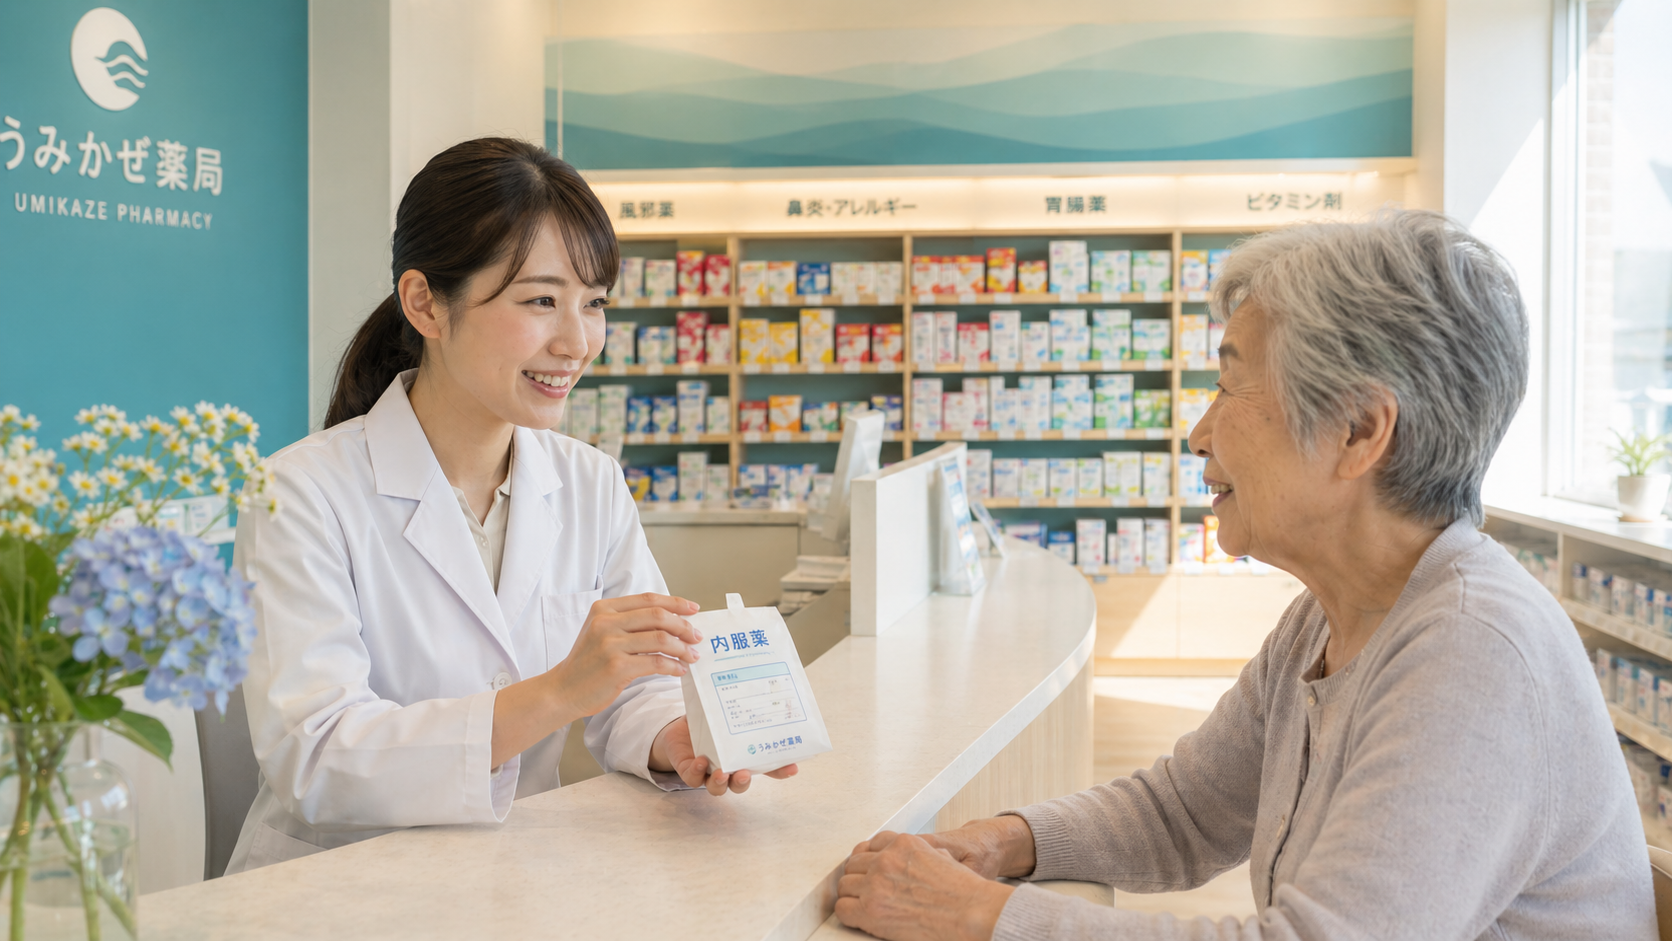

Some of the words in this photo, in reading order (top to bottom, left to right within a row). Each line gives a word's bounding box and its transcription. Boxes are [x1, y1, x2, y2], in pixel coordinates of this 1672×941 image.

[0, 116, 223, 196] うみかぜ薬局
[15, 193, 108, 221] UMIKAZE
[117, 202, 213, 231] PHARMACY
[620, 202, 674, 219] 風邪薬
[1045, 196, 1107, 213] 胃腸薬
[1247, 192, 1343, 211] ビタミン剤
[710, 629, 770, 654] 内服薬
